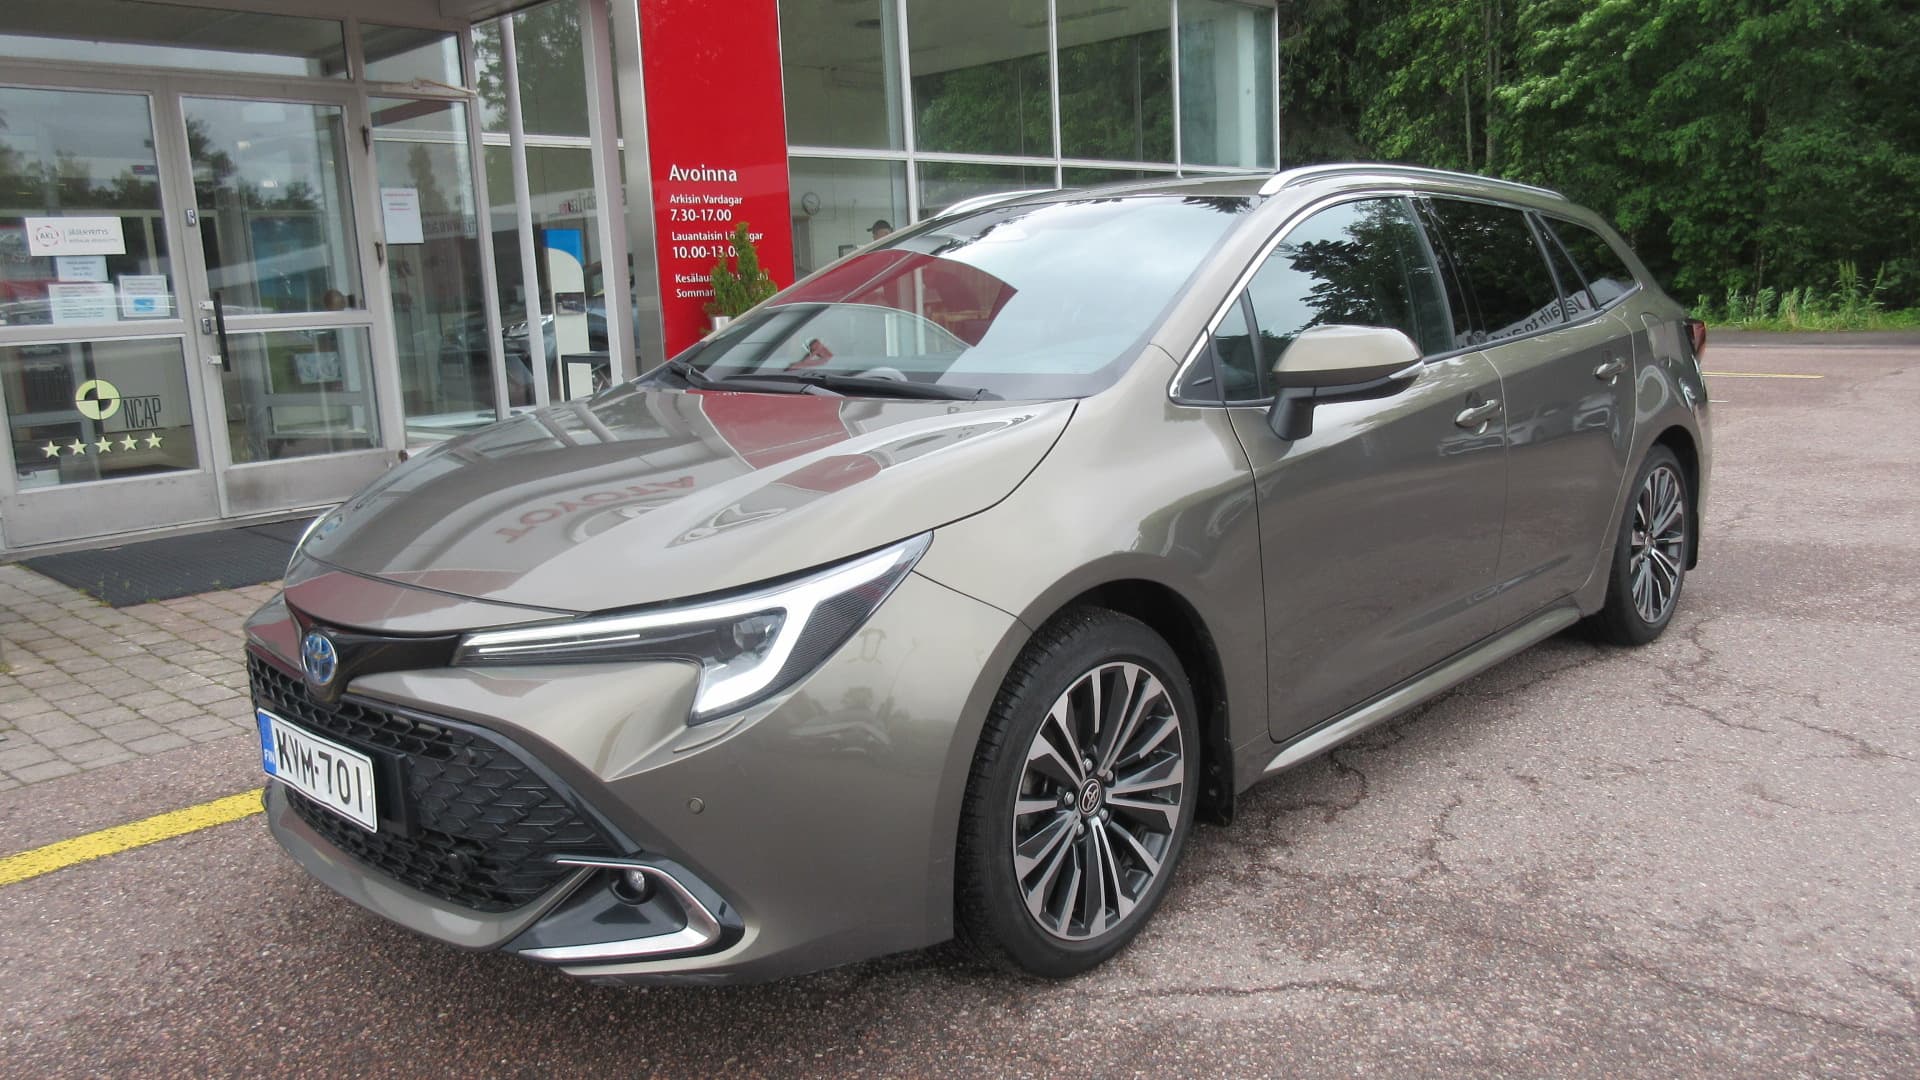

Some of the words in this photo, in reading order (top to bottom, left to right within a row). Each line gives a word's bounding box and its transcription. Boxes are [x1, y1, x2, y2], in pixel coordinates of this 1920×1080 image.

[669, 164, 737, 182] Avoinna
[670, 194, 701, 204] Arkisin
[703, 195, 743, 206] Vardagar
[670, 209, 732, 221] 7.30-17.00
[671, 232, 723, 241] Lauantaisin
[123, 397, 162, 429] NCAP
[275, 727, 364, 814] KYM-701
